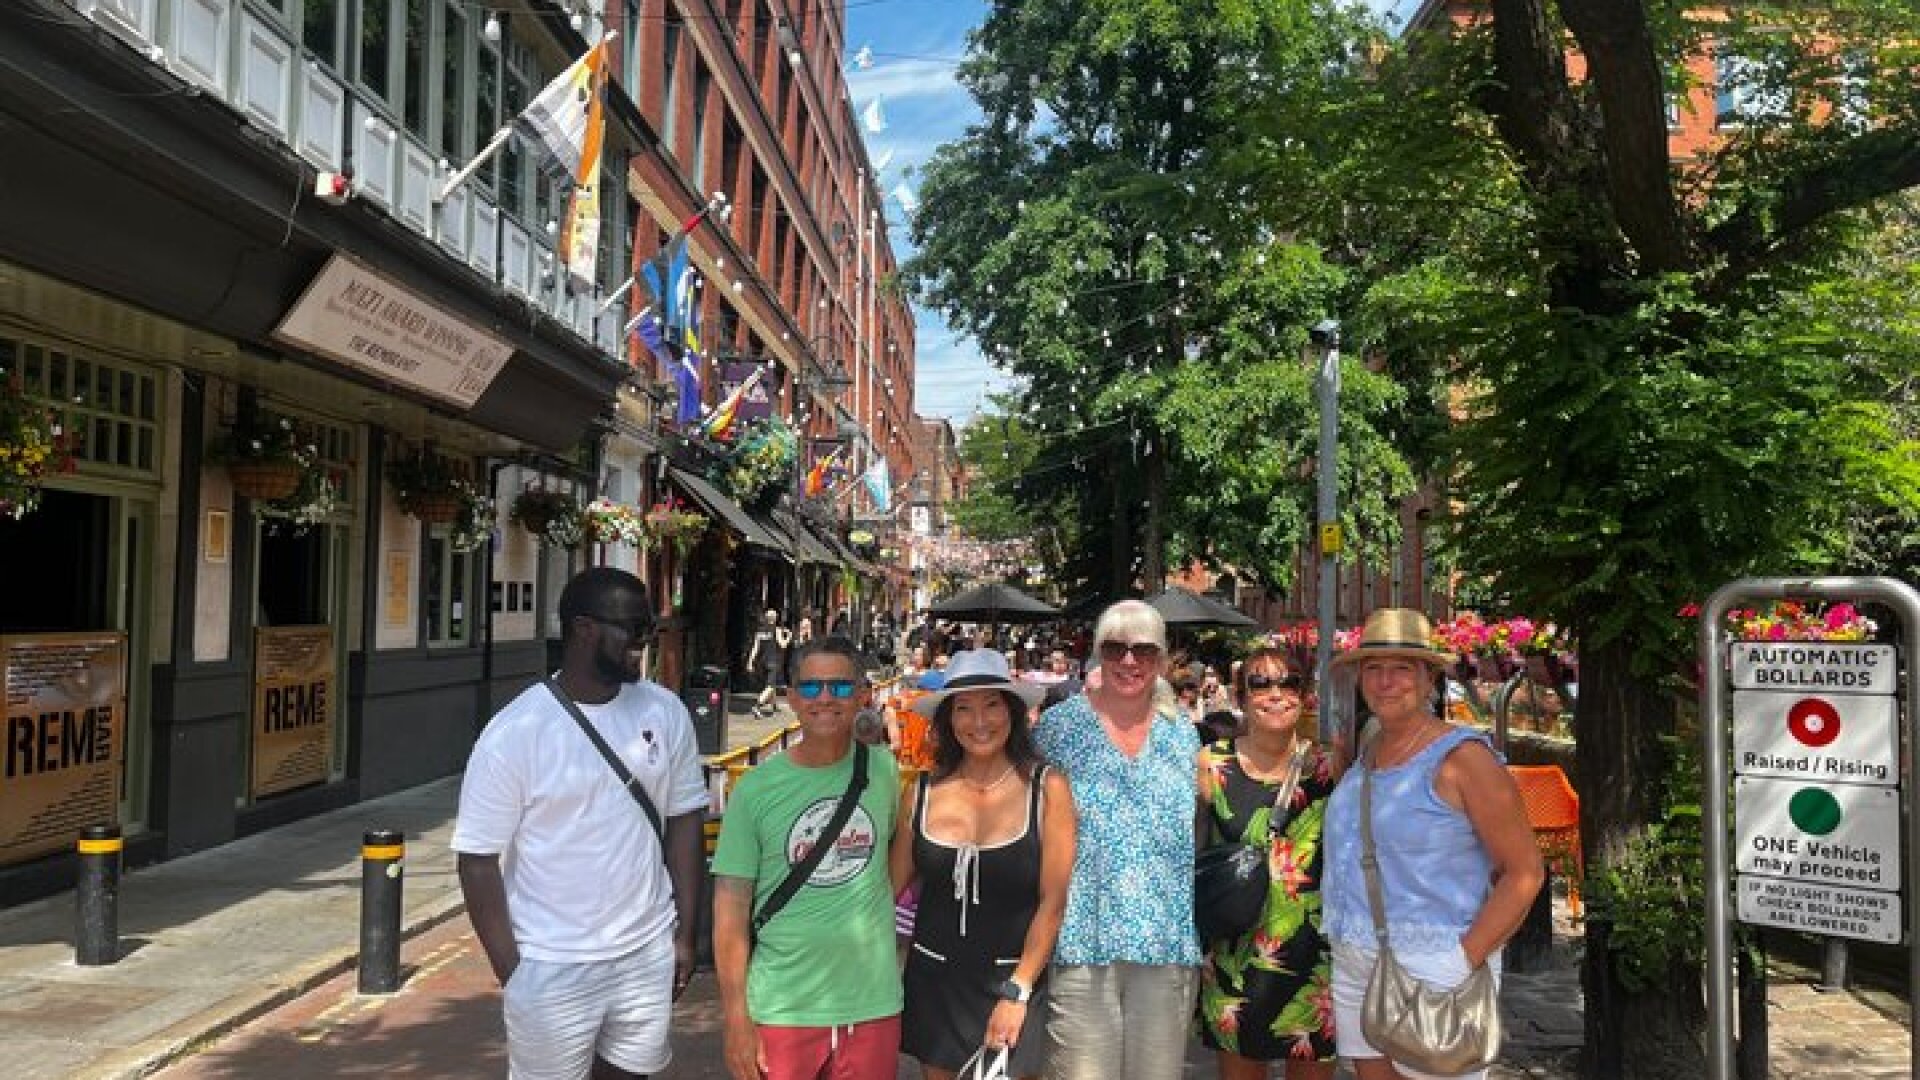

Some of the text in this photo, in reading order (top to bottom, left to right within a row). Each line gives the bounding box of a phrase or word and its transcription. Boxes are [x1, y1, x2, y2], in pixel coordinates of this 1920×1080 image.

[341, 279, 385, 314] MULTI
[382, 300, 427, 334] AWARD
[1748, 648, 1878, 667] AUTOMATIC
[1756, 669, 1873, 687] BOLLARDS
[264, 682, 316, 734] REM
[7, 707, 97, 777] REM
[95, 706, 112, 762] BAR
[1743, 752, 1888, 780] Raised / Rising
[1752, 835, 1881, 865] ONE Vehicle
[1754, 856, 1881, 883] may proceed
[1748, 882, 1889, 910] IF NO LIGHT SHOWS
[1756, 895, 1881, 922] CHECK BOLLARDS
[1769, 911, 1870, 934] ARE LOWERED
